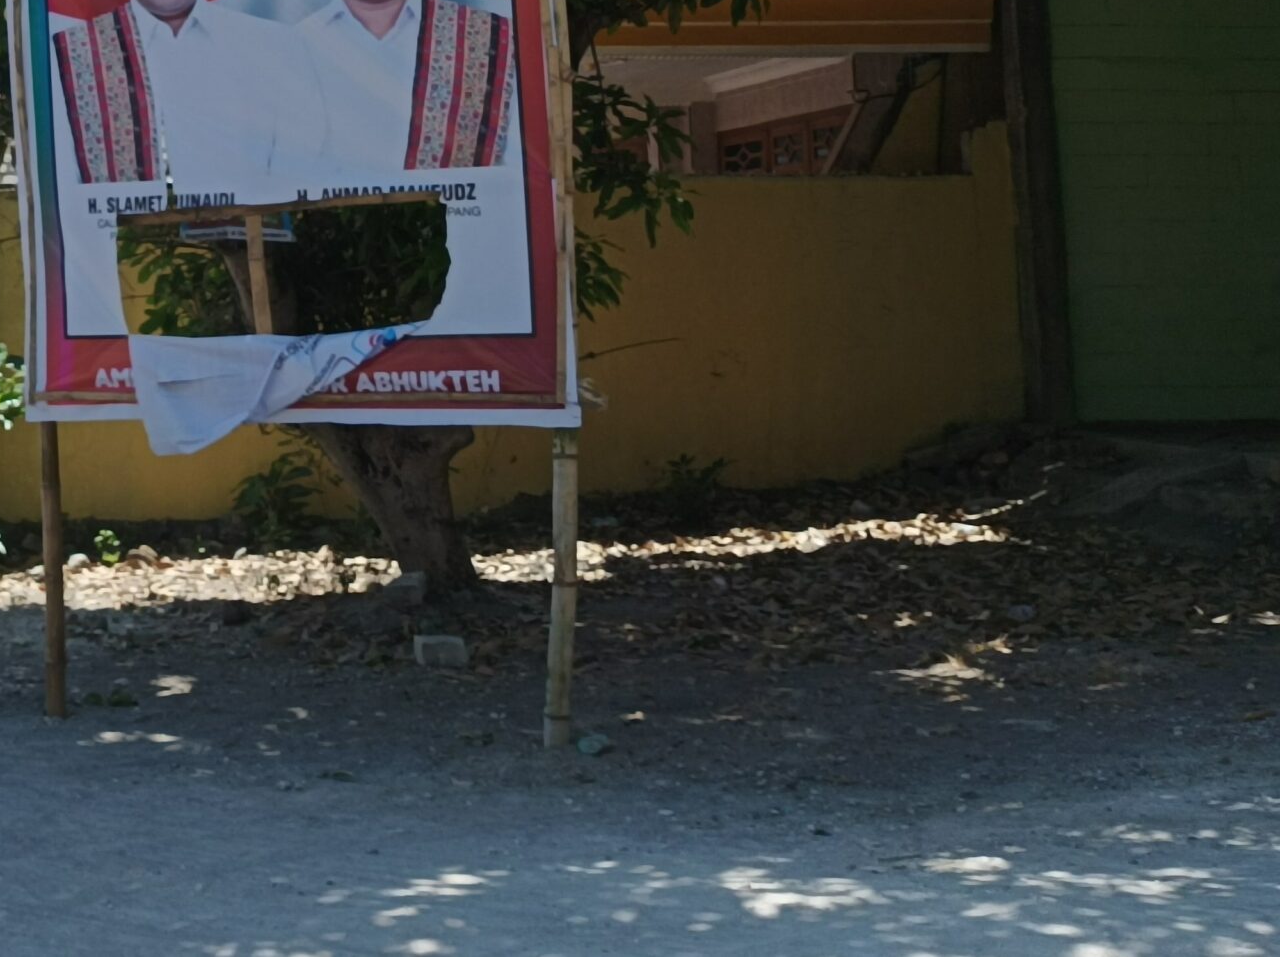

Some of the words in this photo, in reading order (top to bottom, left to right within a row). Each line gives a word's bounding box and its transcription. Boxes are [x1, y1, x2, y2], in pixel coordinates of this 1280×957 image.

[87, 198, 102, 214] H.
[106, 195, 162, 214] SLAMET
[356, 369, 501, 393] ABHUKTEH
